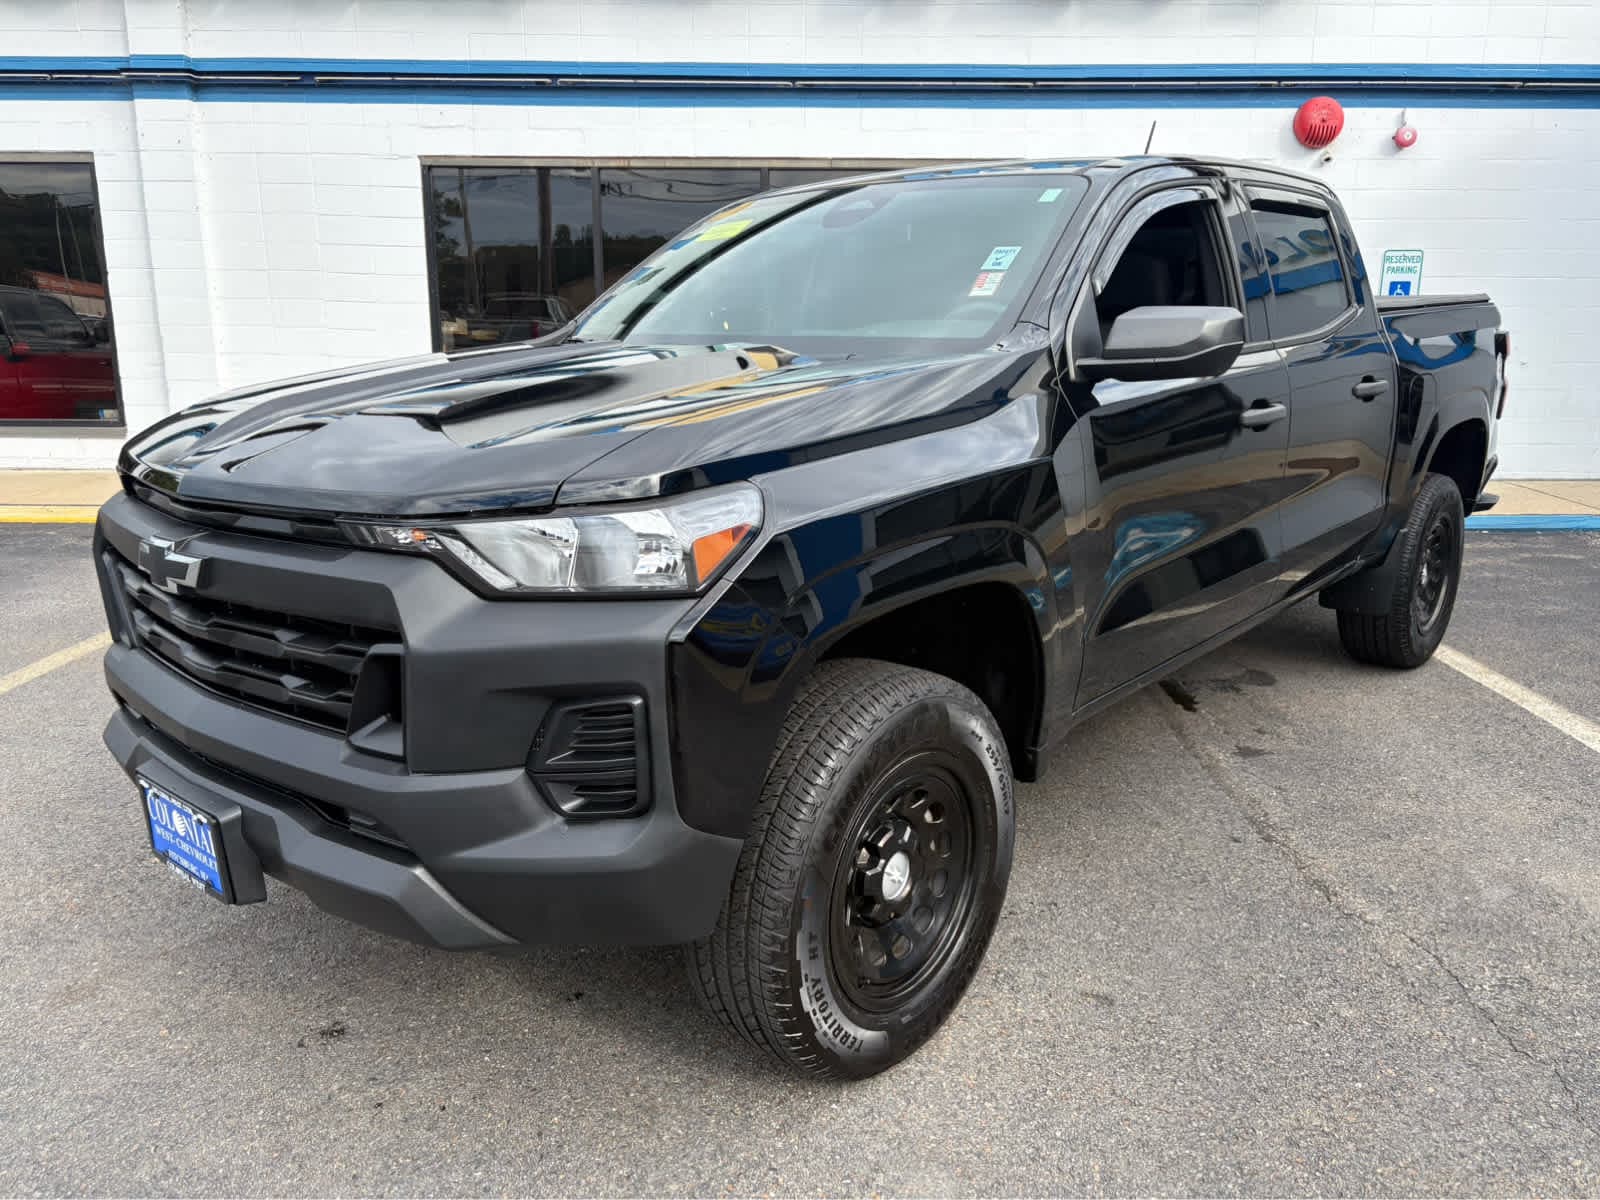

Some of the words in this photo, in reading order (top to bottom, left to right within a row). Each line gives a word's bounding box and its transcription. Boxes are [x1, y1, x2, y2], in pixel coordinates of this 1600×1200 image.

[1385, 255, 1421, 264] RESERVED
[1386, 265, 1418, 275] PARKING
[146, 788, 217, 858] COLONIAL
[810, 976, 864, 1056] TERRITORY
